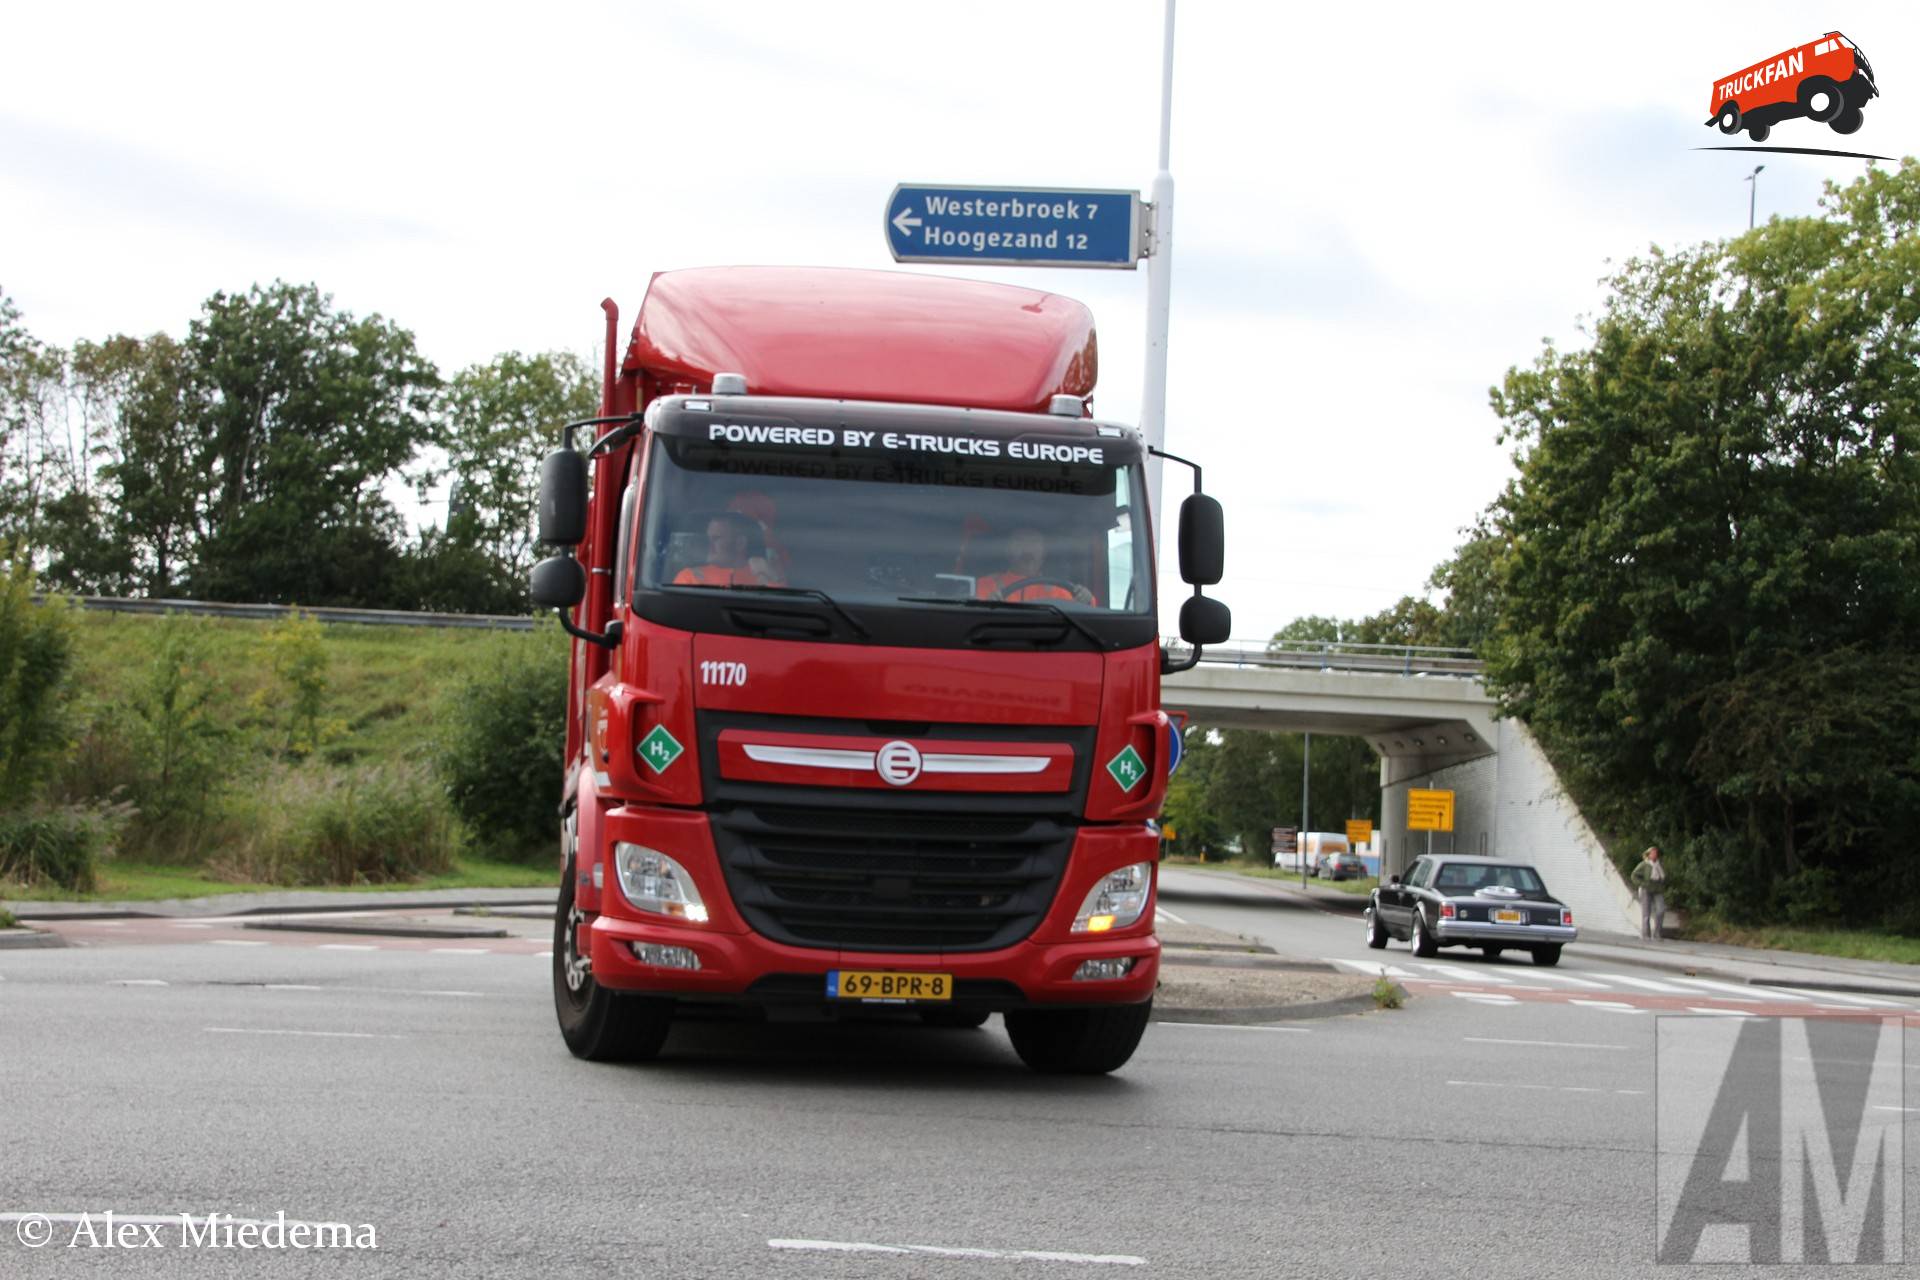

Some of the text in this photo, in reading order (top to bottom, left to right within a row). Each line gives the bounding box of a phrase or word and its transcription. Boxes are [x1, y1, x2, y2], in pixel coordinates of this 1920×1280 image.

[925, 196, 1099, 220] Westerbroek 7
[924, 227, 1089, 251] Hoogezand 12
[708, 424, 1104, 465] POWERED BY E-TRUCKS EUROPE
[700, 660, 747, 687] 11170
[844, 974, 944, 996] 69-BPR-8
